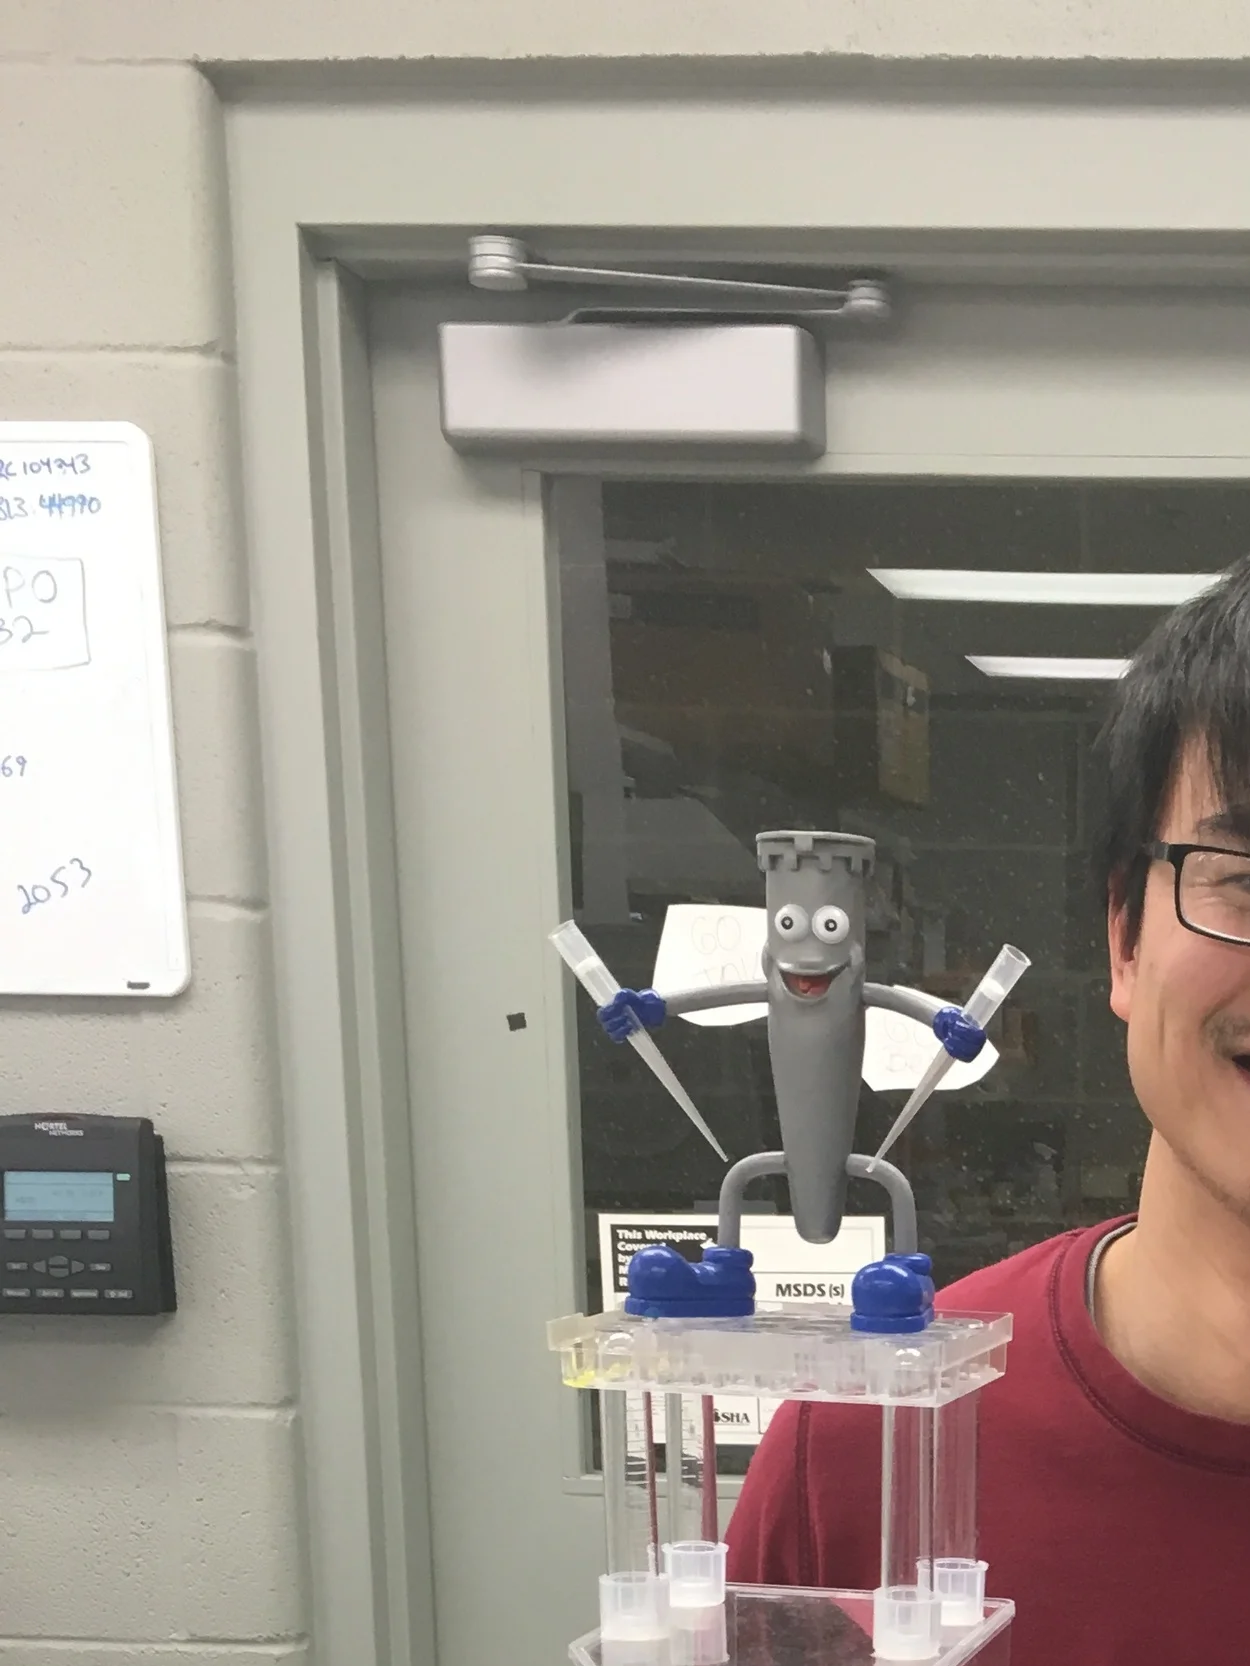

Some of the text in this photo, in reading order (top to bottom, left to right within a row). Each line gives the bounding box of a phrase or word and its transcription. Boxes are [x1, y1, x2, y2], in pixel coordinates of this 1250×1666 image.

[616, 1229, 708, 1243] This Workplace
[775, 1282, 846, 1299] MSDS (s)
